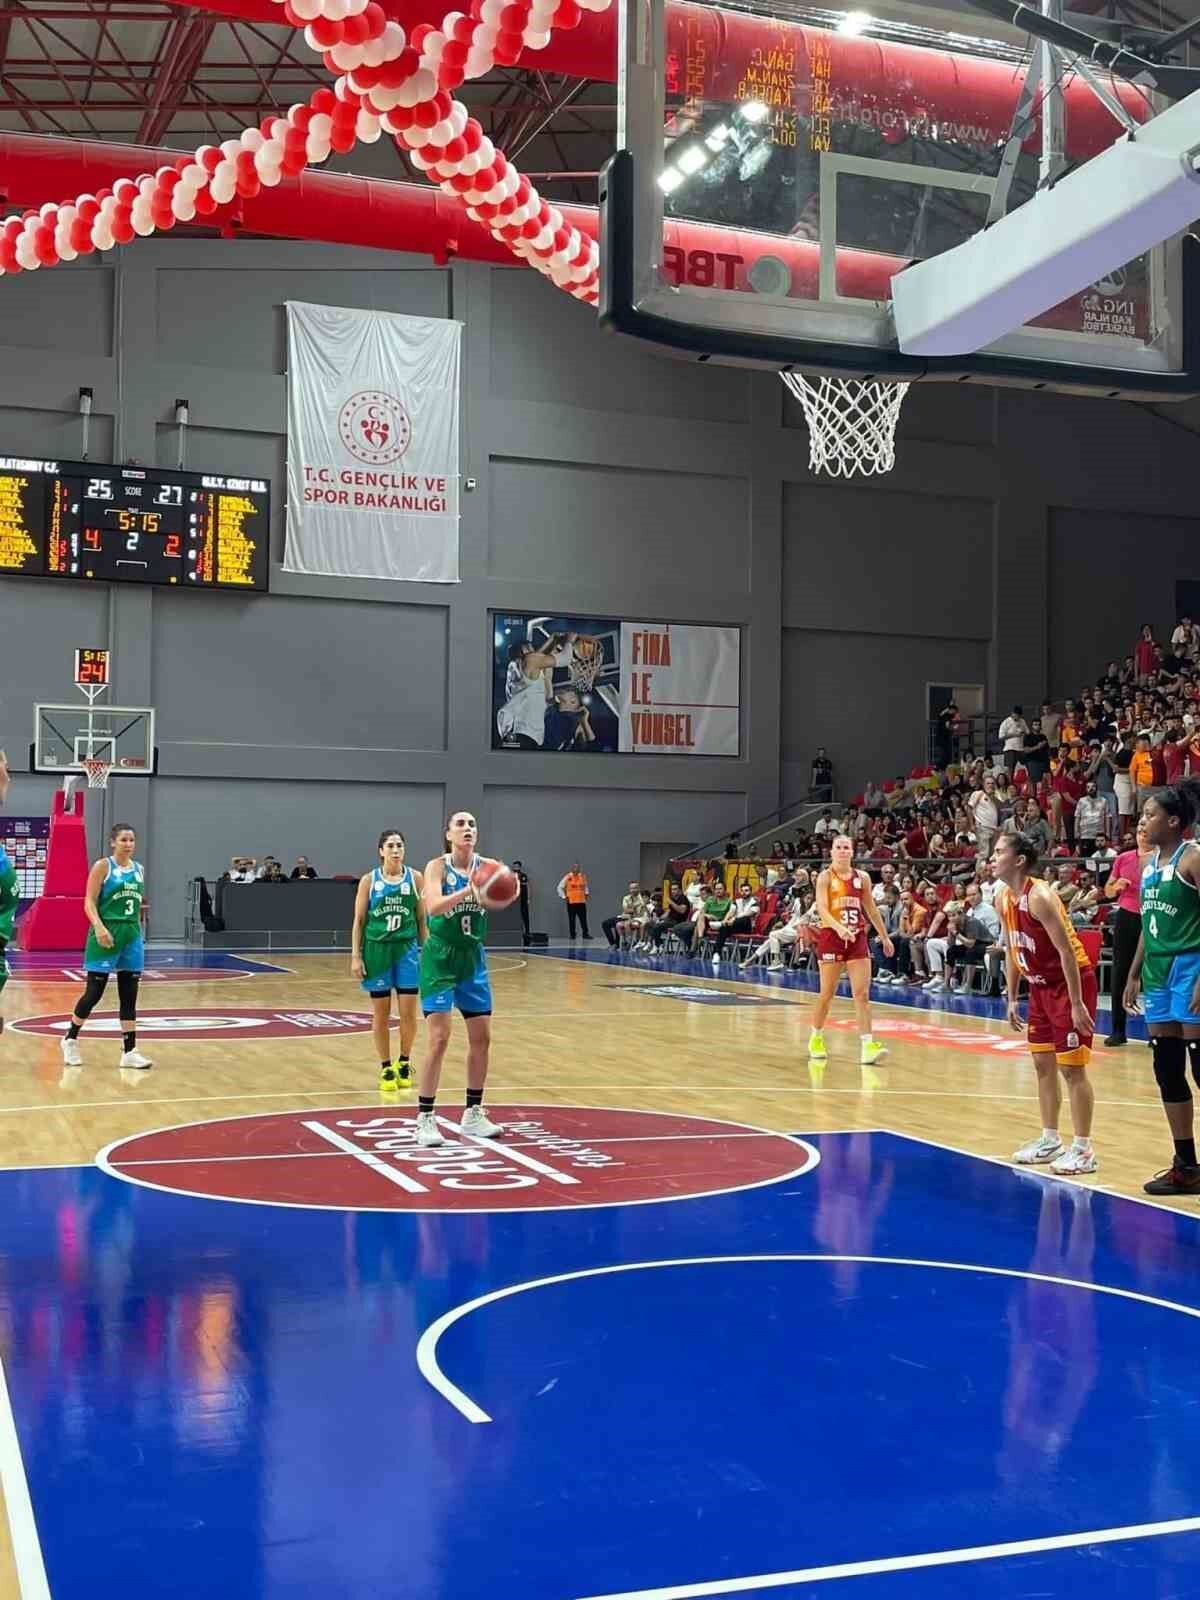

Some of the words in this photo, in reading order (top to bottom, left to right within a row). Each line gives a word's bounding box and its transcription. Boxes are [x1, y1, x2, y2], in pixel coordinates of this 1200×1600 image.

[87, 478, 112, 498] 25
[304, 467, 334, 483] T.C.
[340, 470, 418, 491] GENÇLİK
[425, 478, 446, 492] VE
[159, 485, 182, 503] 27
[304, 487, 349, 505] SPOR
[354, 491, 446, 512] BAKANLIĞI
[119, 512, 158, 532] 5:15
[85, 528, 98, 549] 4
[126, 532, 139, 550] 2
[166, 535, 179, 555] 2
[80, 663, 104, 682] 24
[631, 672, 653, 705] LE
[124, 899, 134, 915] 3
[385, 914, 402, 932] 10
[461, 915, 471, 935] 8
[841, 910, 858, 925] 35
[1149, 914, 1158, 938] 4
